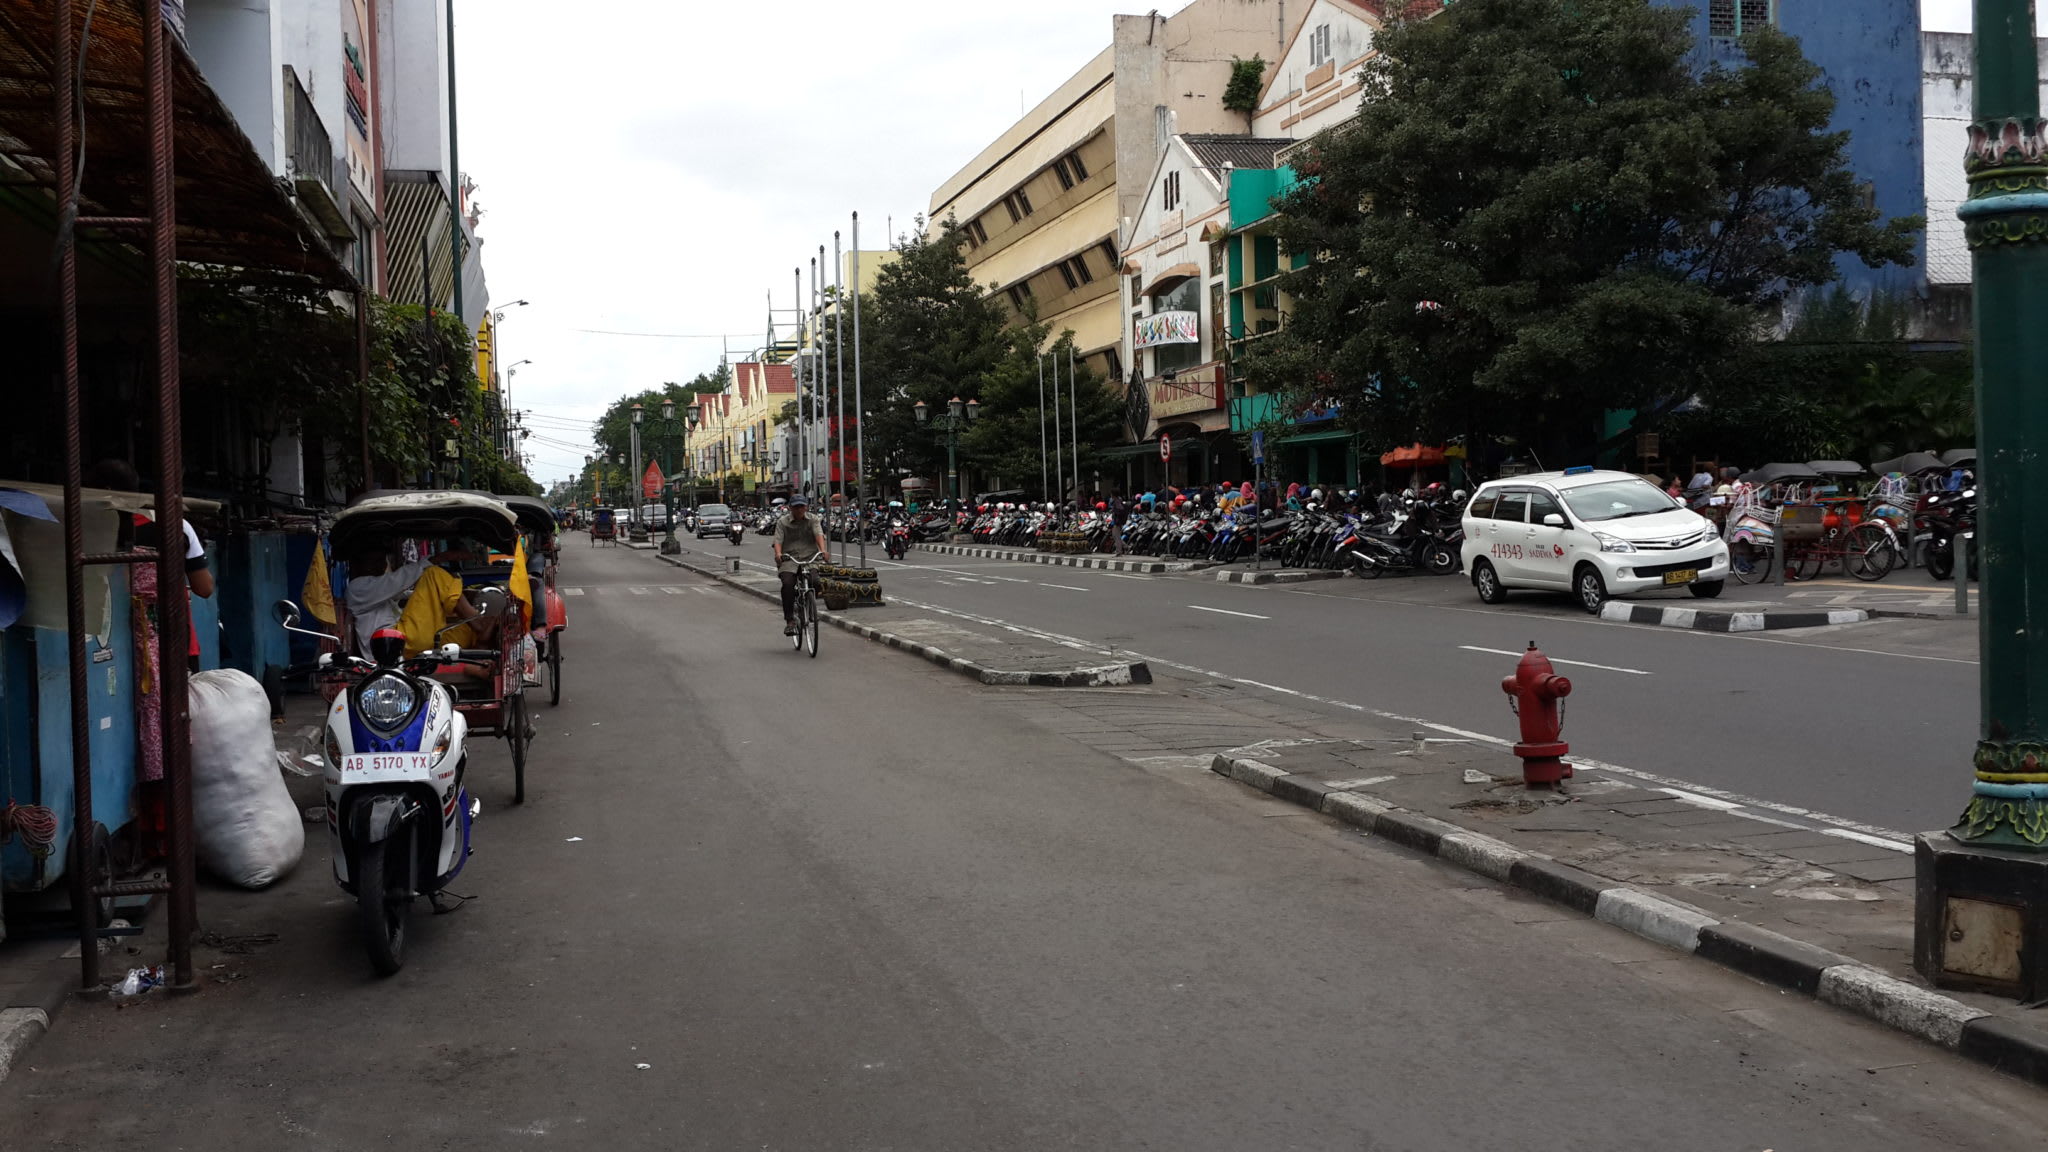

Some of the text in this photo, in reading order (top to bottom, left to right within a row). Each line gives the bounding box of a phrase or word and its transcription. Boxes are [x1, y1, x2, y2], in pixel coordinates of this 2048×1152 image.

[1491, 543, 1523, 560] 414343
[346, 756, 427, 771] AB 5170 YX
